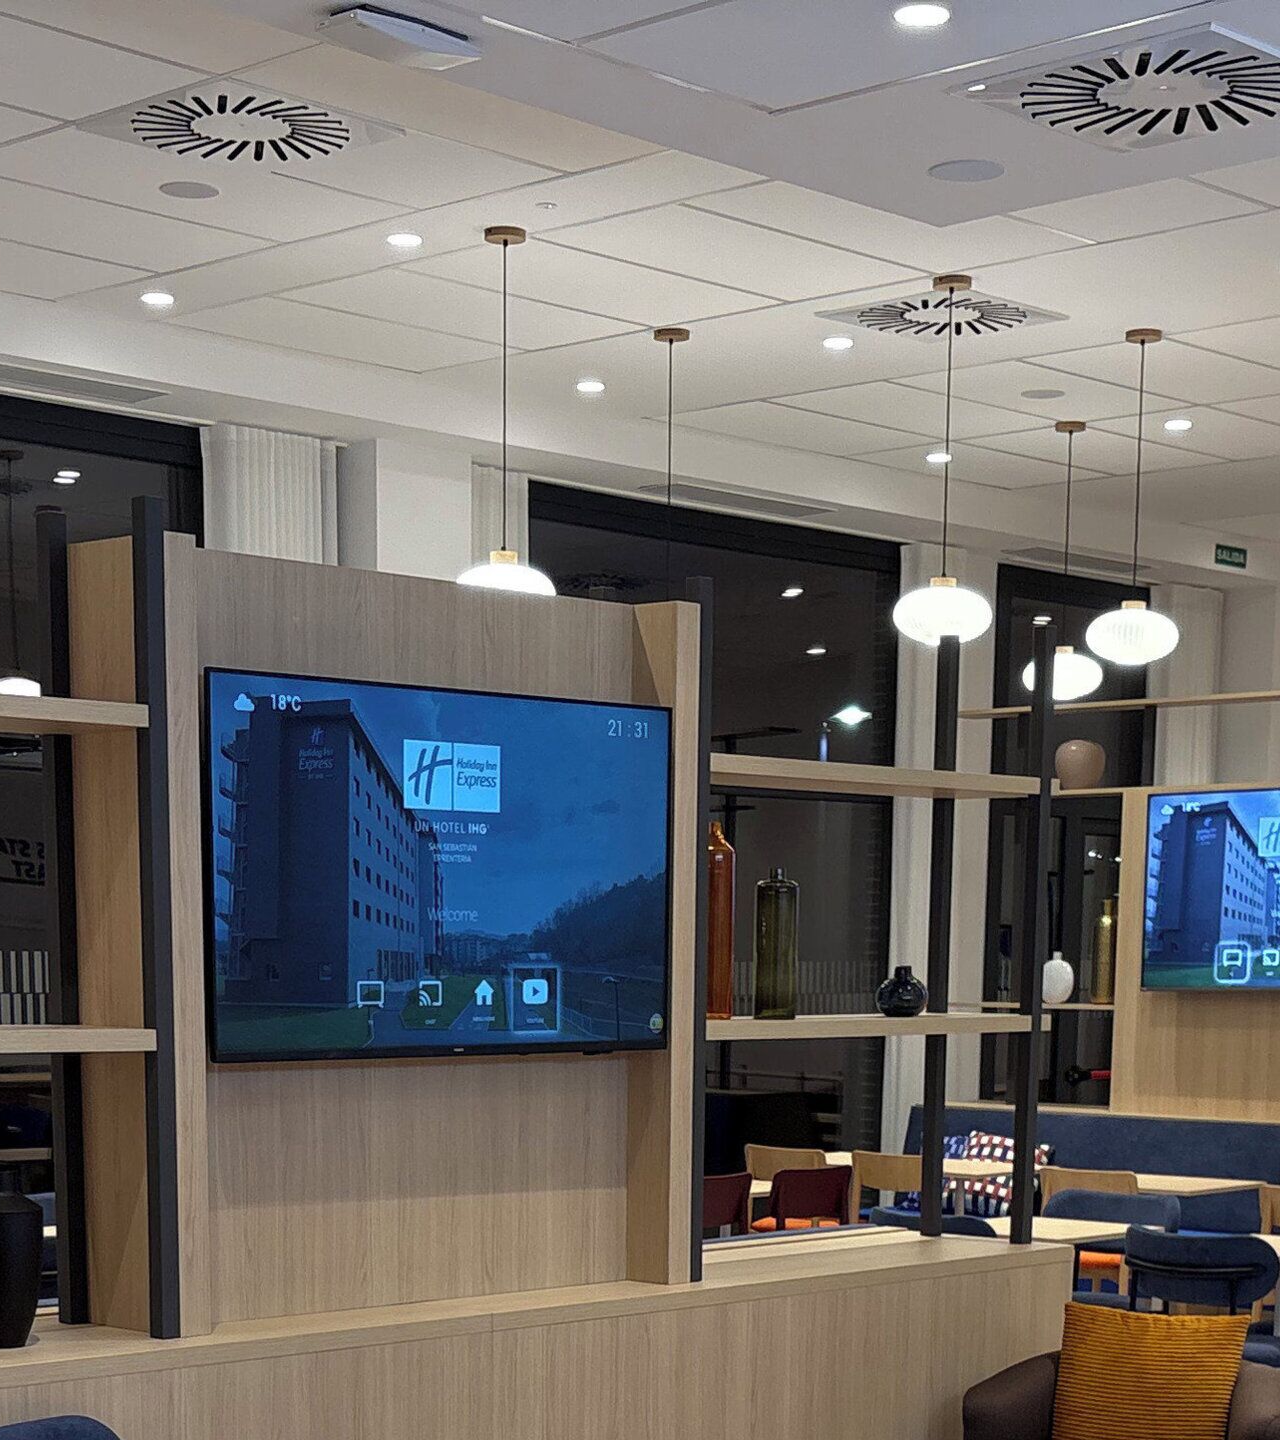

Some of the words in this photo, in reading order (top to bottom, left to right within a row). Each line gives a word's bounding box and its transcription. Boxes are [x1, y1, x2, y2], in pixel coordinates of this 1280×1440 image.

[270, 693, 301, 712] 18°C
[456, 758, 484, 772] Holiday
[486, 759, 498, 771] Inn
[456, 771, 498, 790] Express
[433, 821, 467, 834] HOTEL
[427, 907, 479, 921] Welcome
